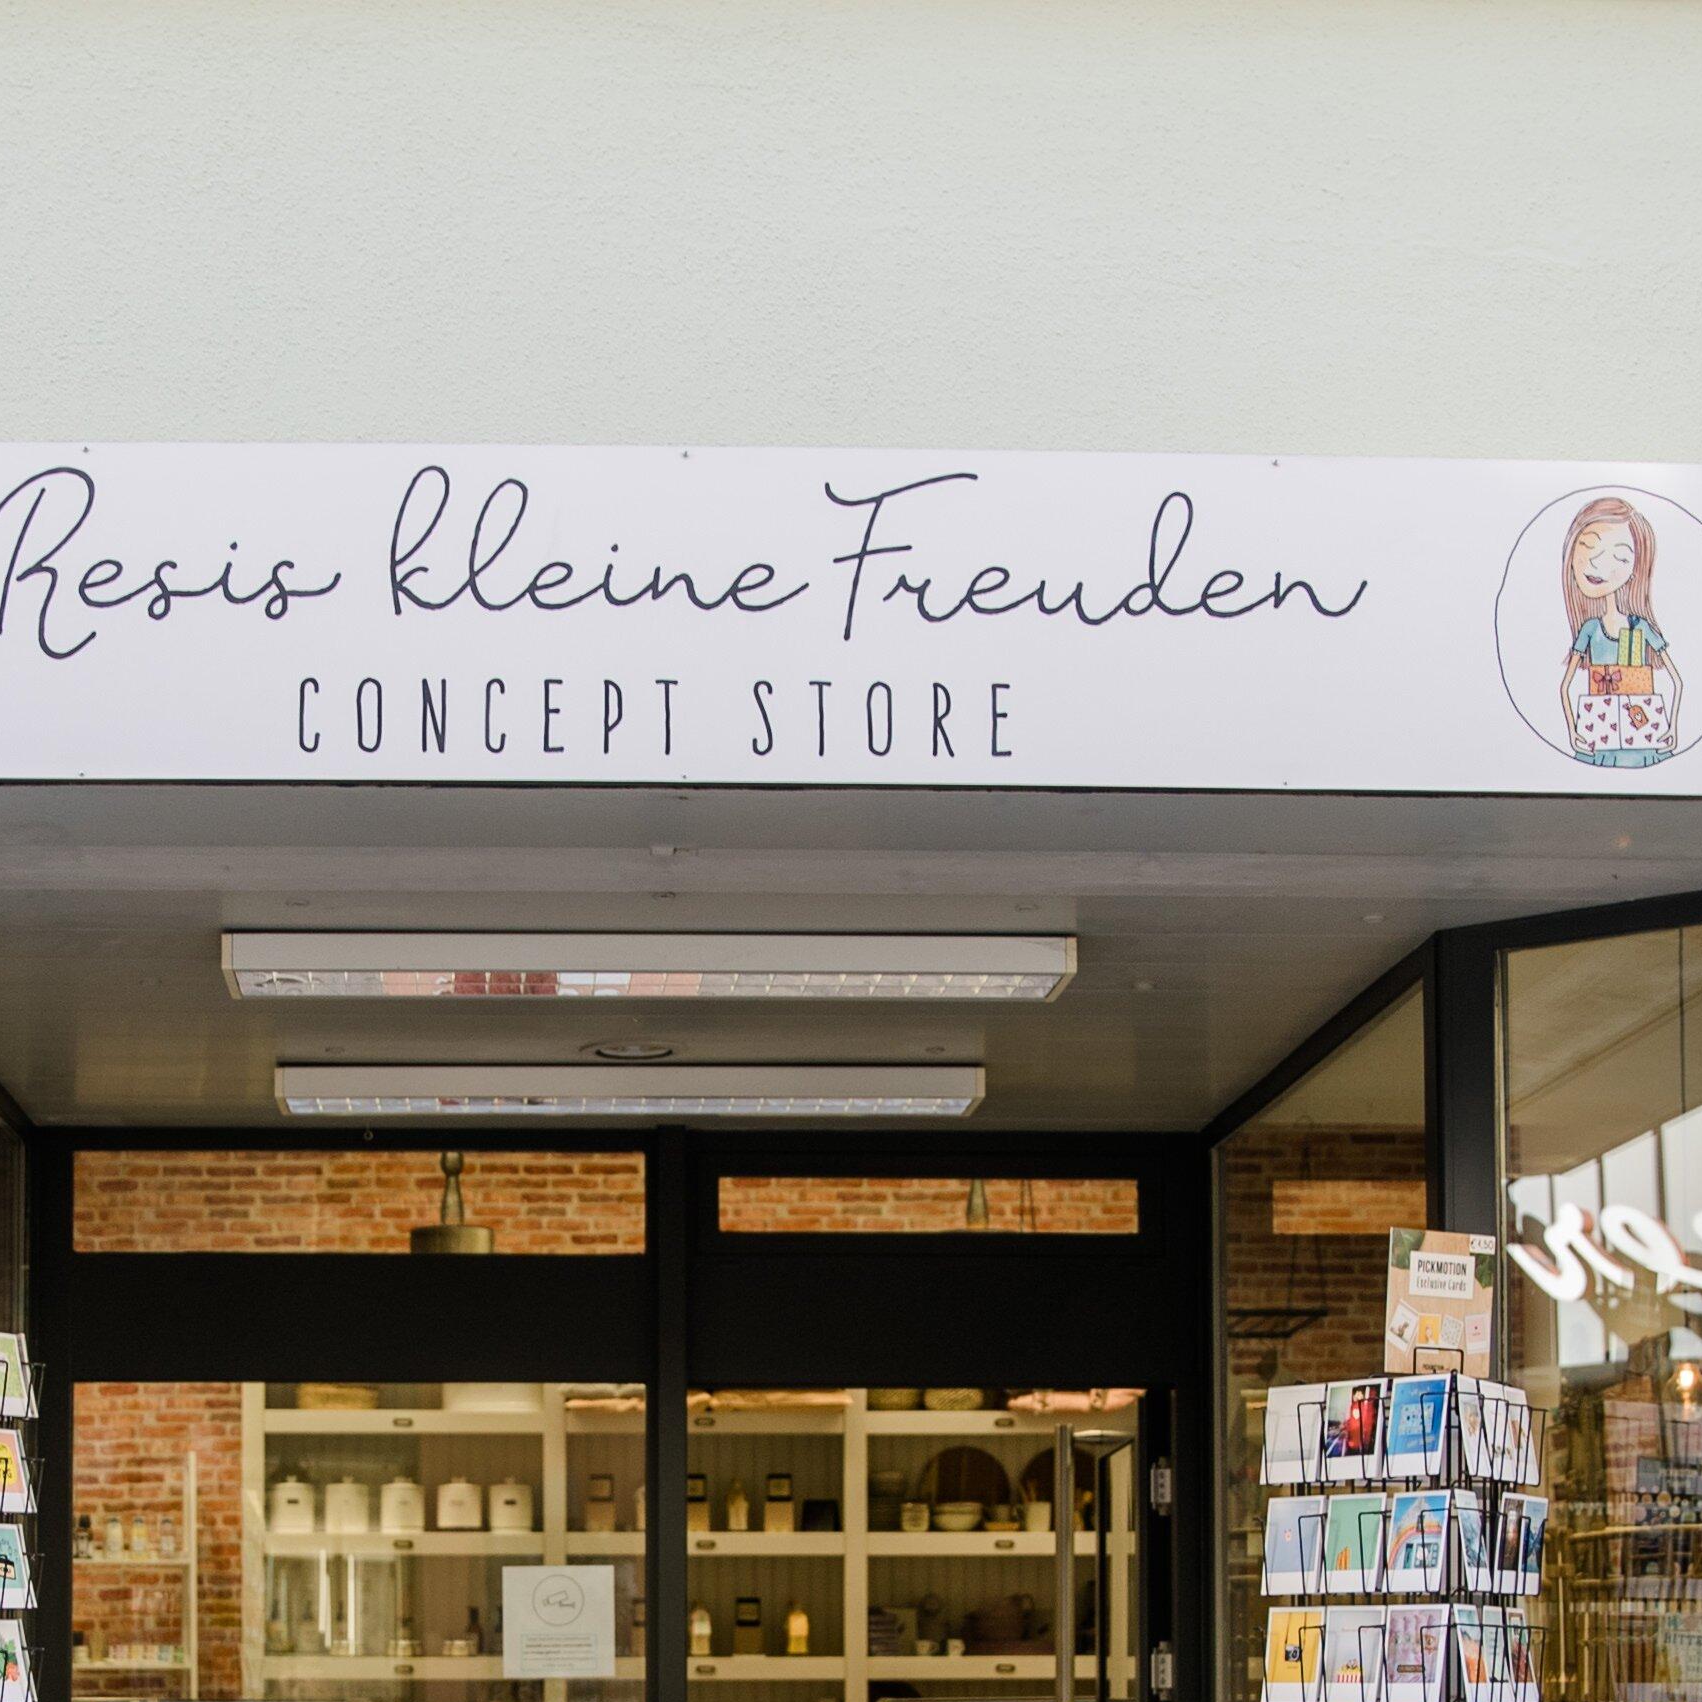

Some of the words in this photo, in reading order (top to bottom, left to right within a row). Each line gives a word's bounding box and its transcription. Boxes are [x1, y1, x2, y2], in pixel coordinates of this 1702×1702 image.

[388, 464, 811, 618] kleine
[822, 471, 1368, 642] Freuden
[297, 676, 682, 757] CONCEPT
[749, 678, 1015, 759] STORE
[1417, 1259, 1468, 1277] PICKMOTION
